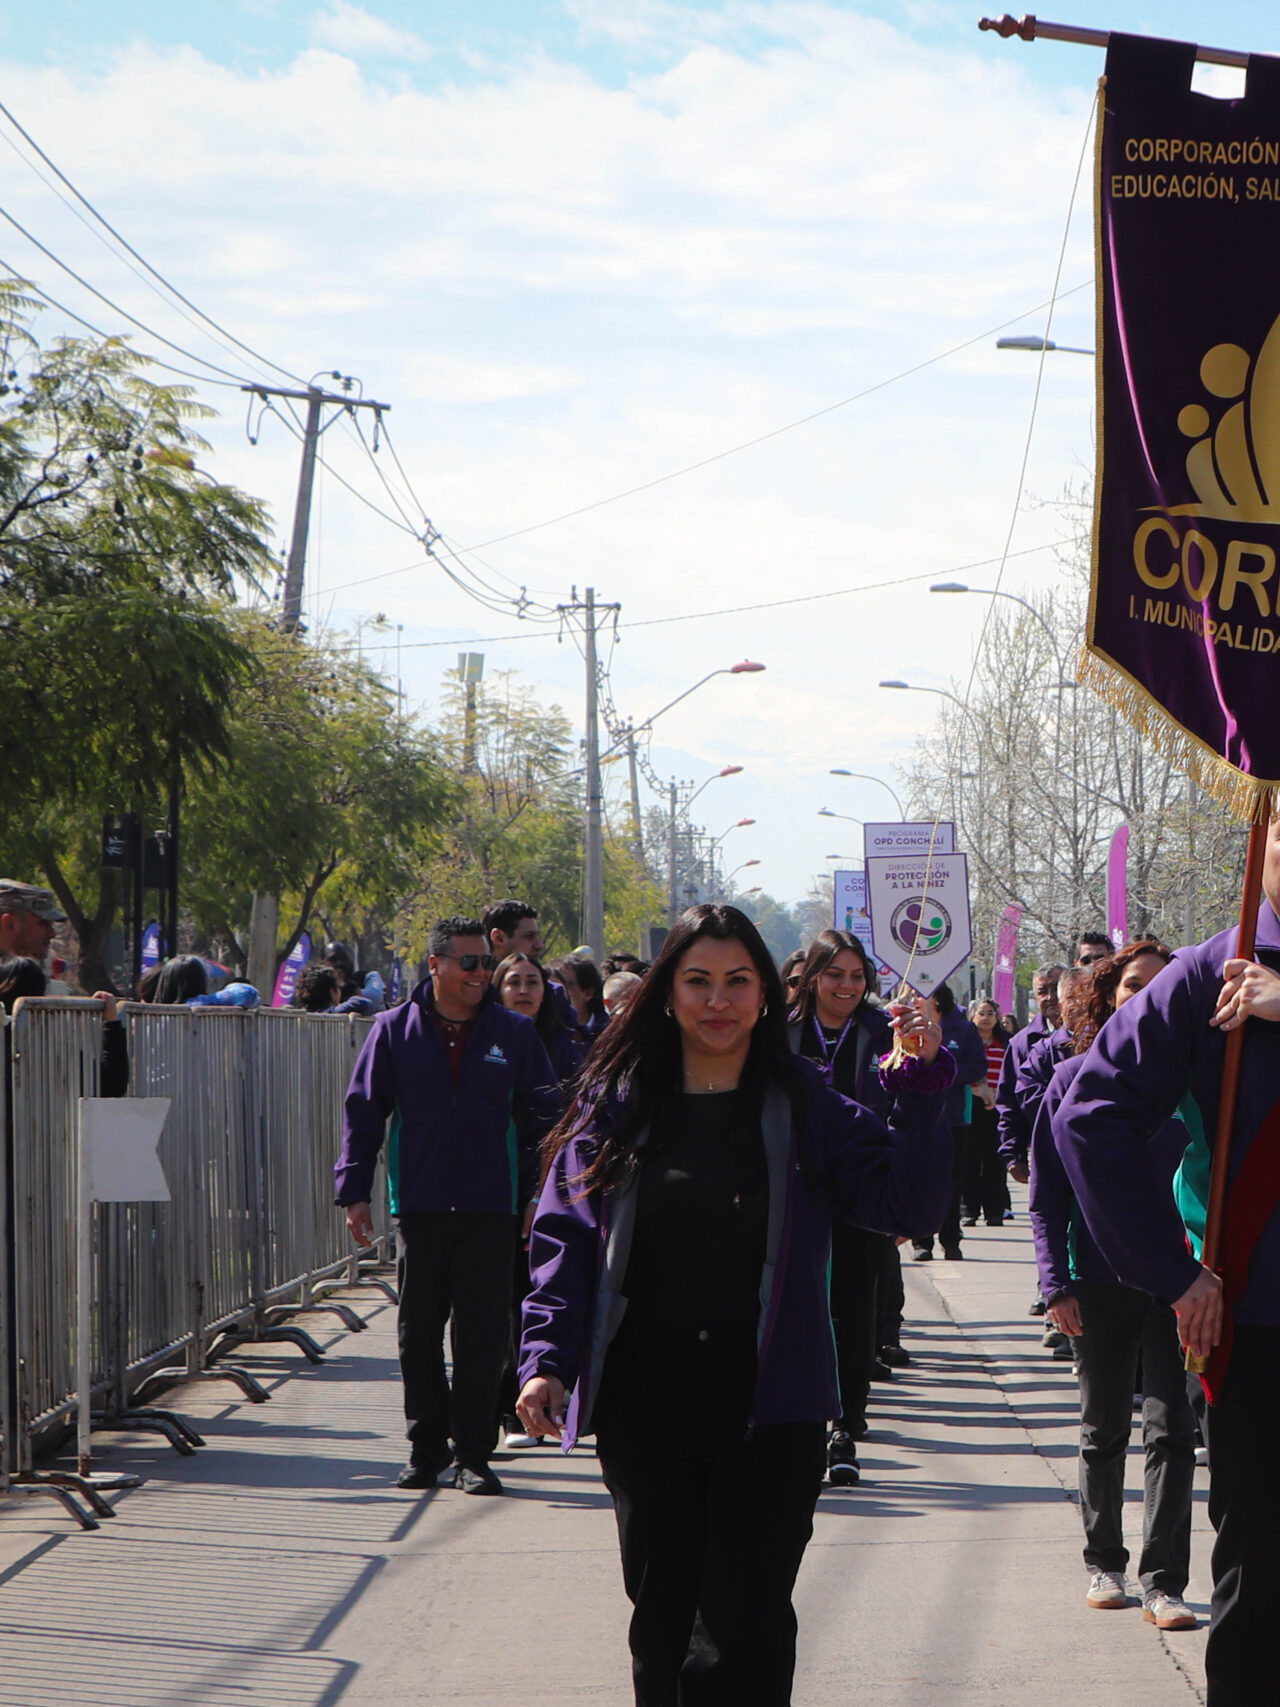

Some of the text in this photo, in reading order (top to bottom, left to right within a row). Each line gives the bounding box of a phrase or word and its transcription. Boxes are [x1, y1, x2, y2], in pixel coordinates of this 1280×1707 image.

[1125, 137, 1279, 165] CORPORACIÓN
[1111, 172, 1240, 204] EDUCACIÓN,
[1129, 594, 1138, 619] I.
[874, 837, 893, 845] OPD
[892, 879, 945, 889] A LA NÑEZ
